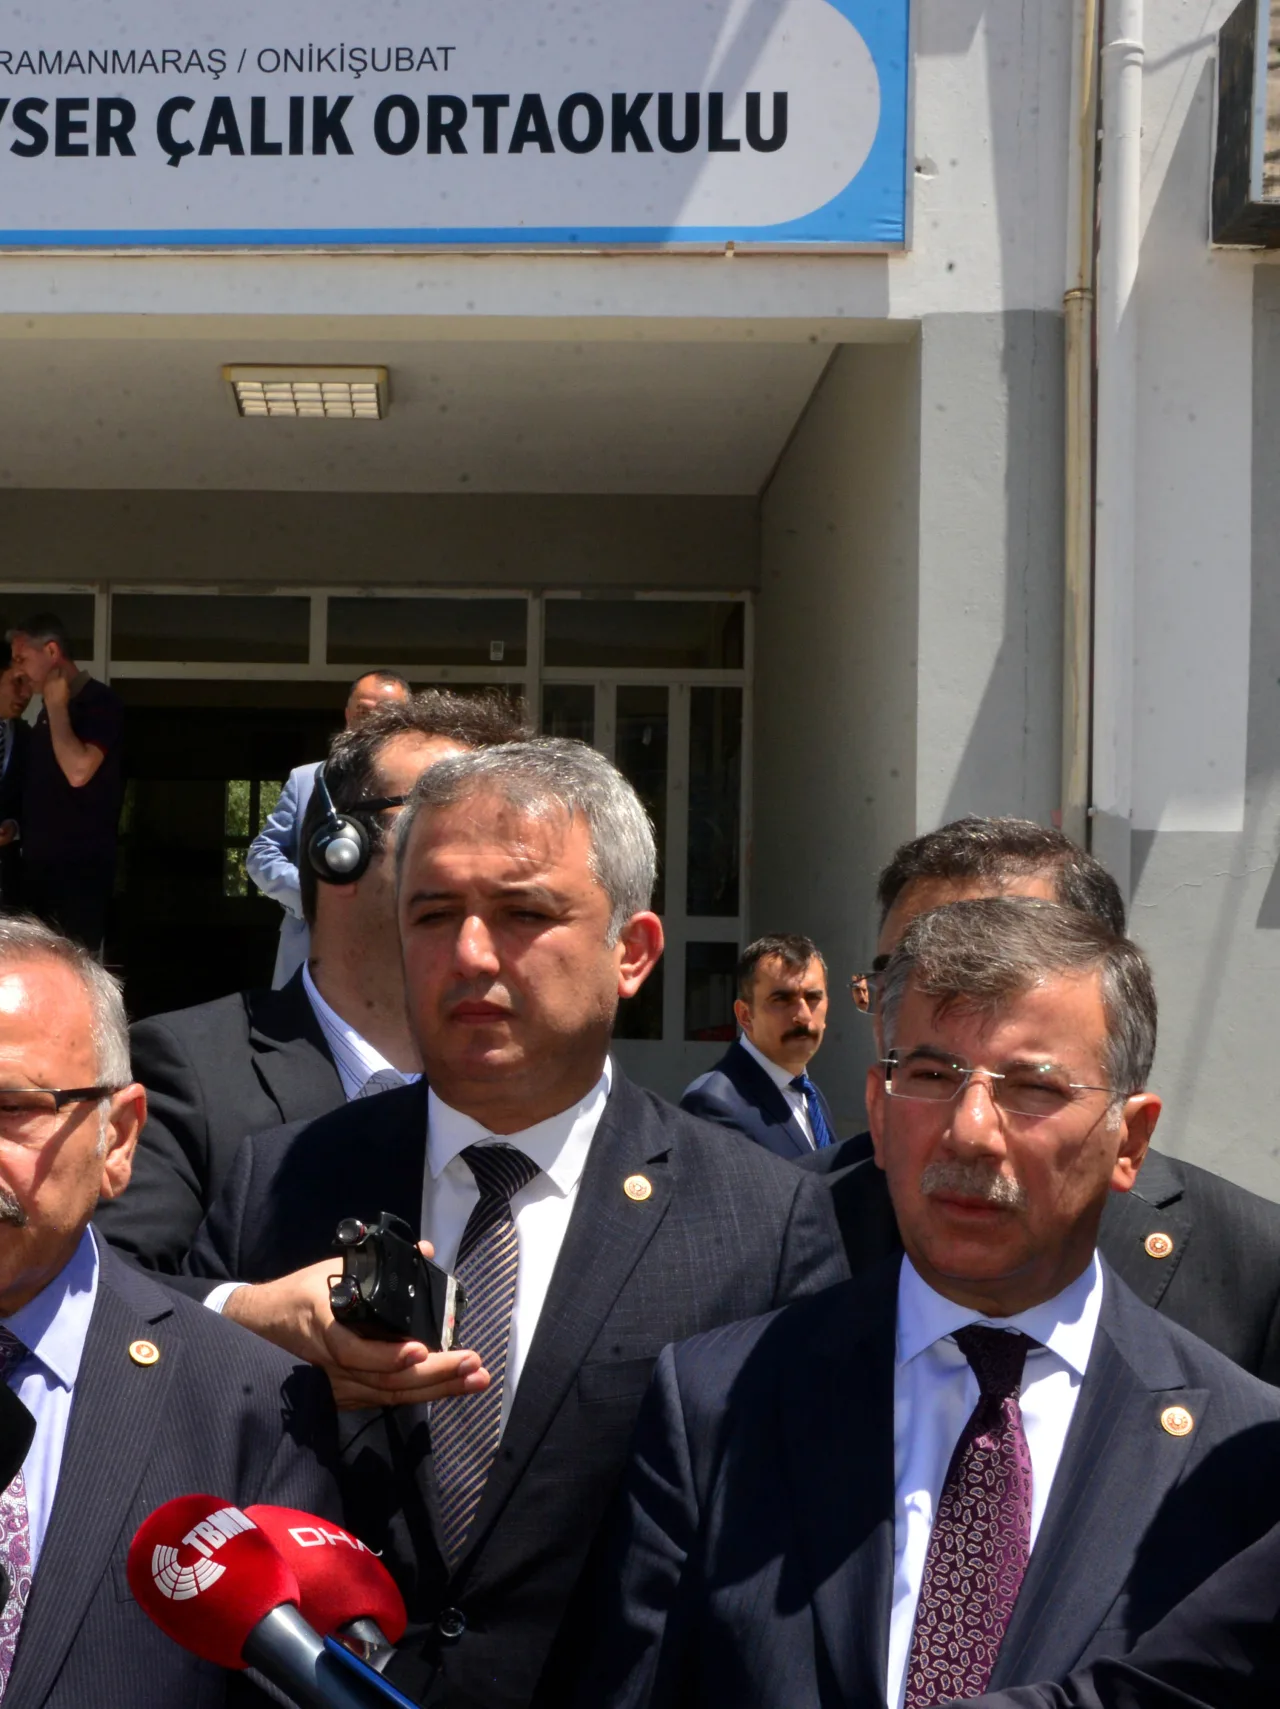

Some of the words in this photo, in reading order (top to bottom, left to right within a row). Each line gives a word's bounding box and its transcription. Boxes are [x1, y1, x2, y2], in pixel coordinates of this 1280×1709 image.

[237, 48, 247, 74] /
[257, 43, 456, 79] ONİKİŞUBAT
[156, 96, 354, 168] ÇALIK
[374, 92, 788, 156] ORTAOKULU
